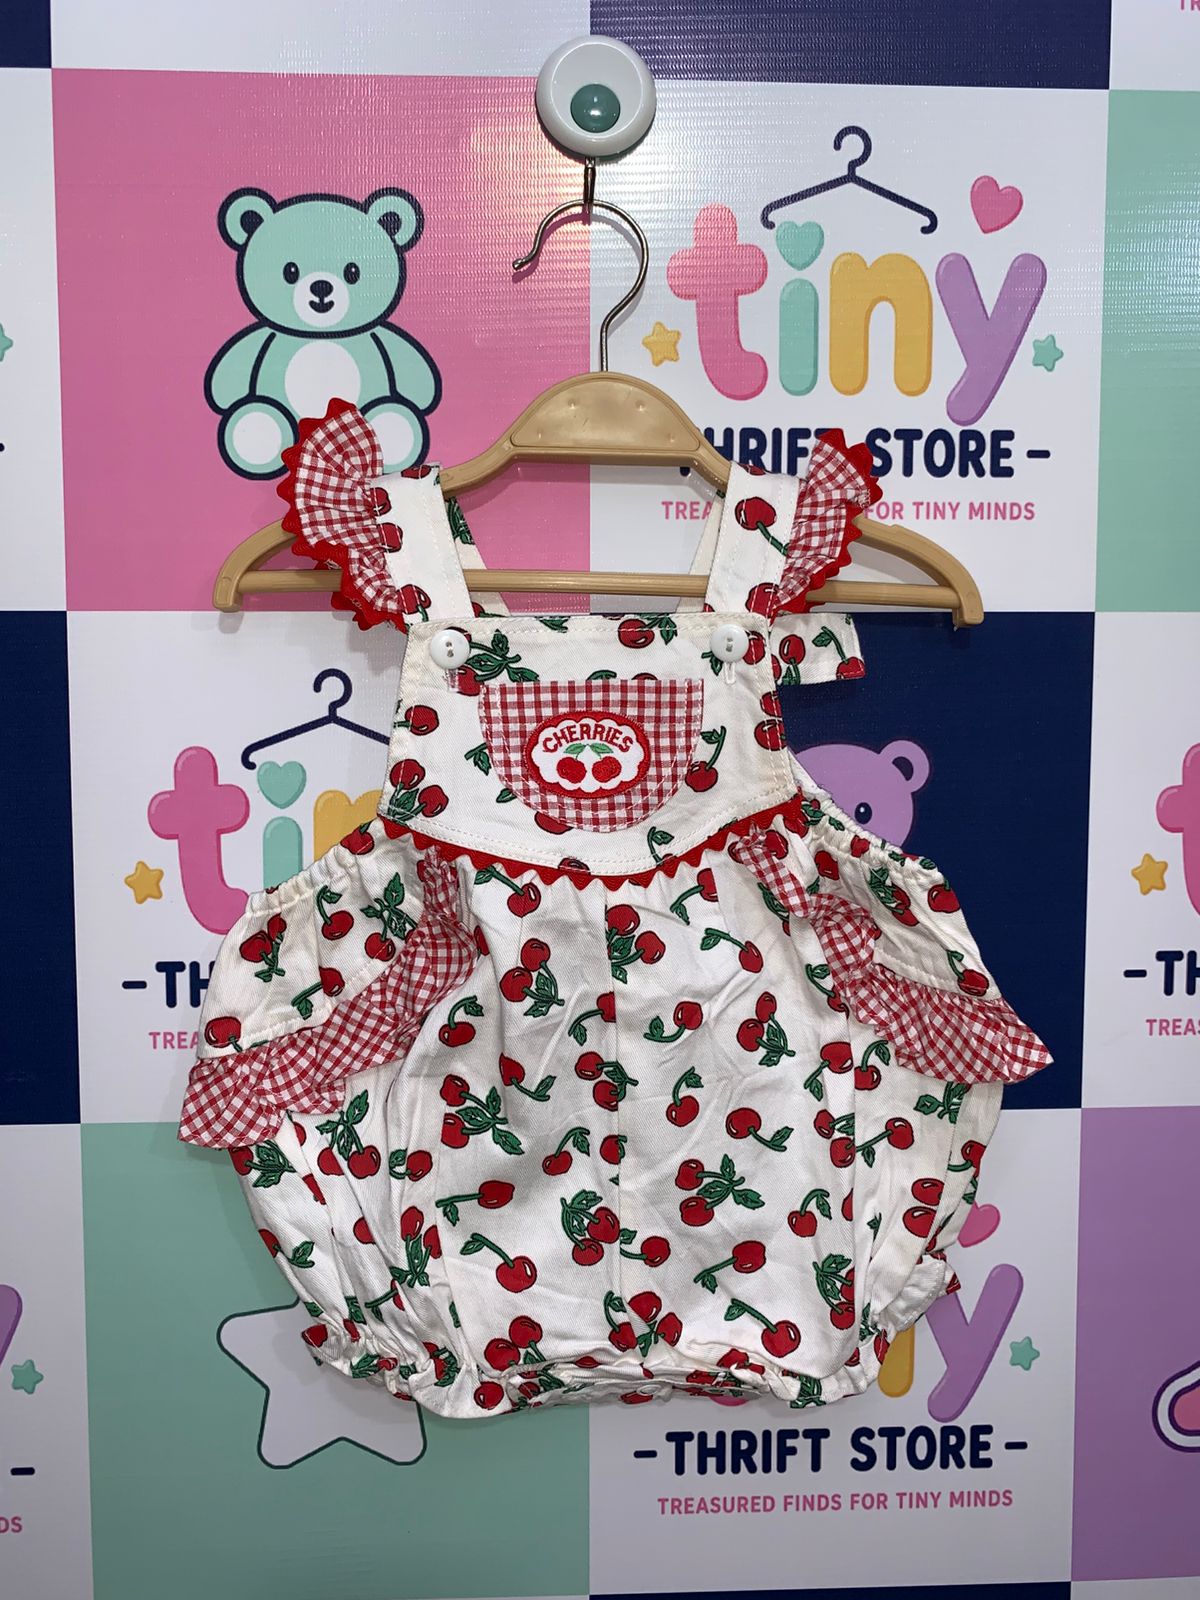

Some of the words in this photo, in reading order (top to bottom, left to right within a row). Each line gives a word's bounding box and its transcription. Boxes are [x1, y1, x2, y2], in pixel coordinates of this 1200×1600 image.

[667, 203, 1047, 427] tiny
[680, 427, 842, 477] HRIF
[865, 428, 1015, 478] STORE
[912, 501, 960, 520] TINY
[968, 502, 1036, 521] MINDS
[542, 723, 634, 753] CHERRIES
[665, 1428, 831, 1476] THRIFT
[850, 1424, 994, 1472] STORE
[657, 1495, 776, 1515] TREASURED
[783, 1493, 842, 1512] FINDS
[850, 1492, 888, 1511] FOR
[896, 1491, 942, 1509] TINY
[949, 1489, 1013, 1508] MINDS
